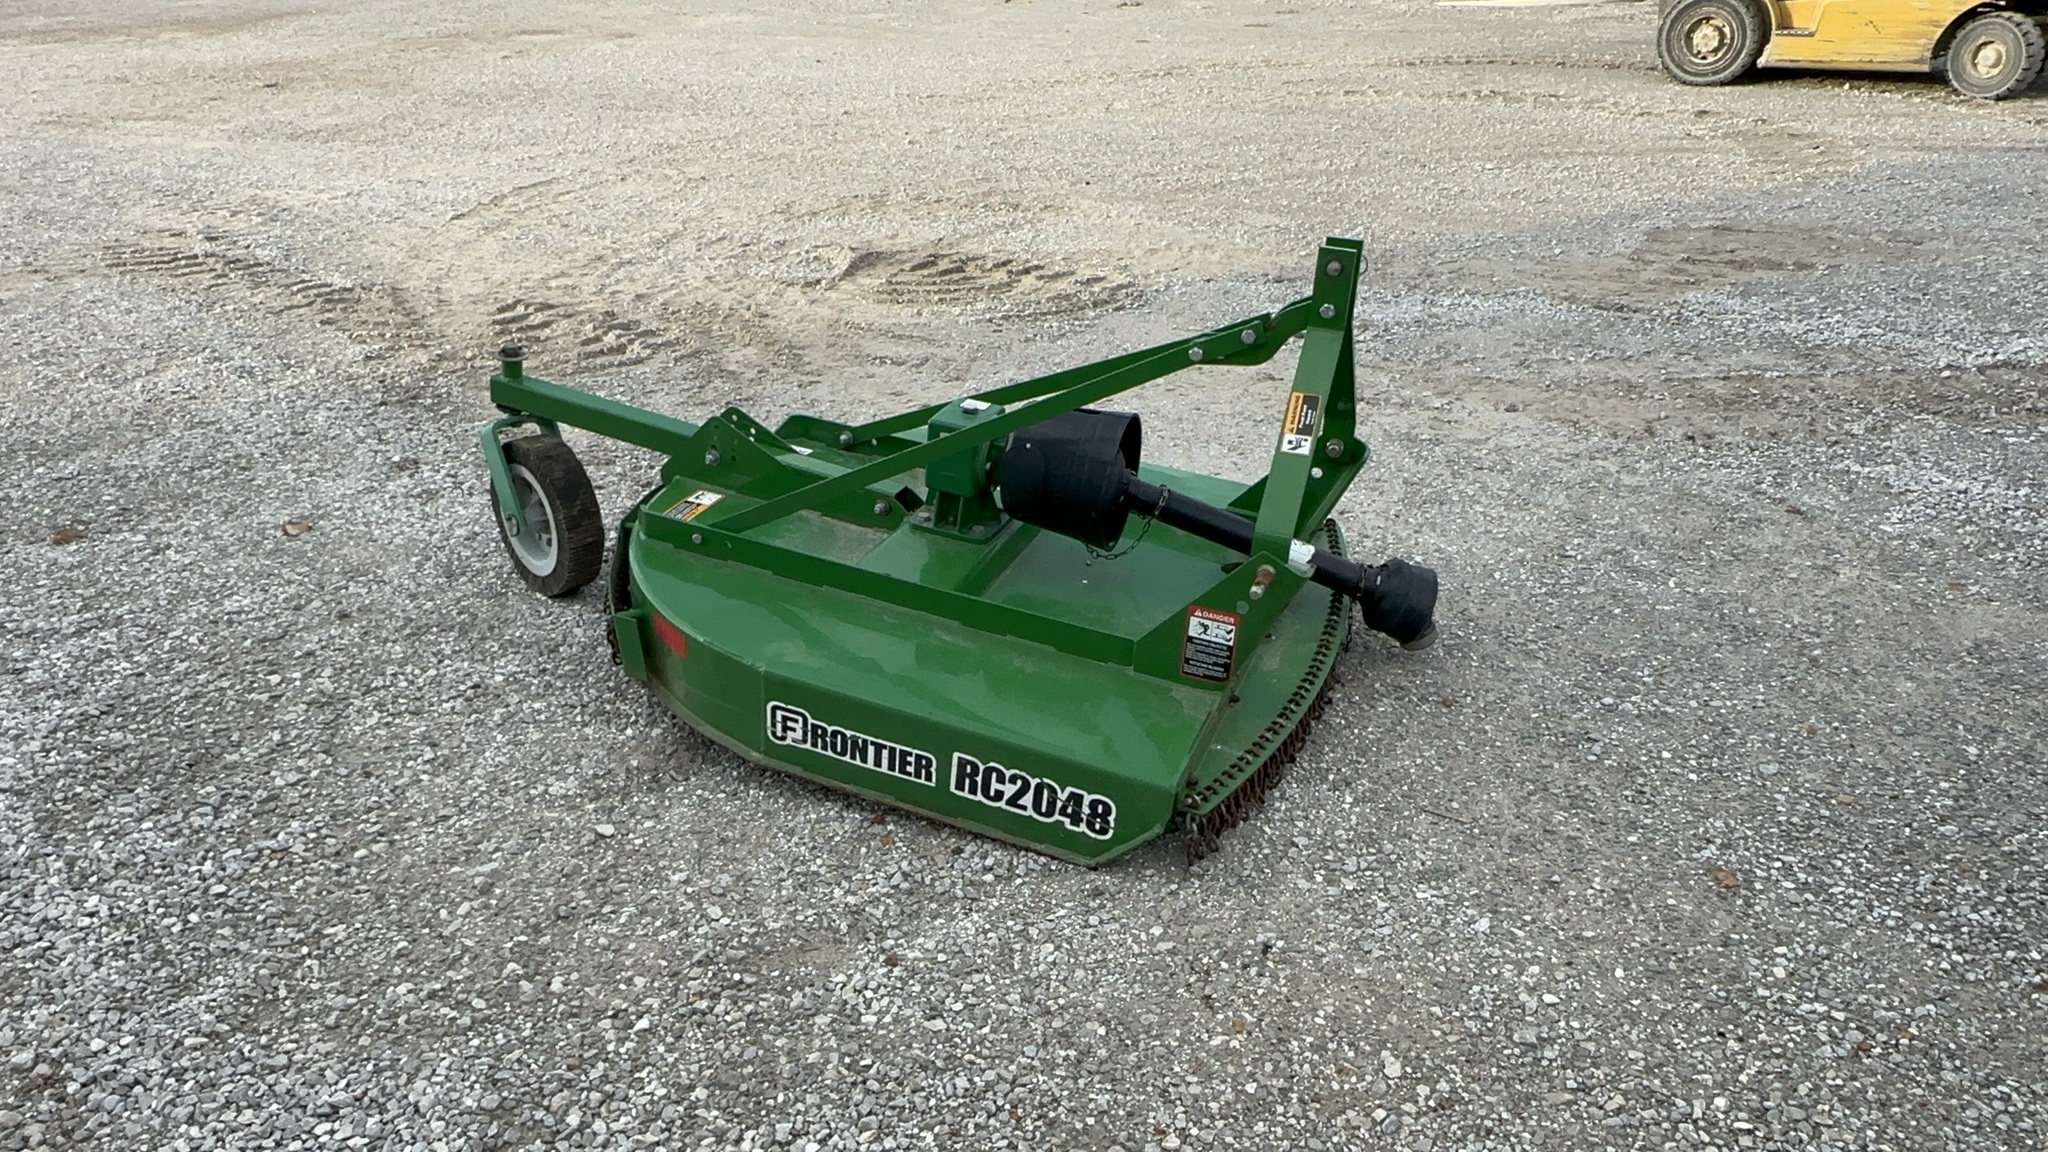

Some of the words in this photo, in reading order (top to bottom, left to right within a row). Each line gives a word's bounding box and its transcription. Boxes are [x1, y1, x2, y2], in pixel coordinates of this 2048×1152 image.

[1202, 611, 1235, 624] DANGER
[768, 702, 935, 785] FRONTIER
[952, 754, 1114, 838] RC2048
